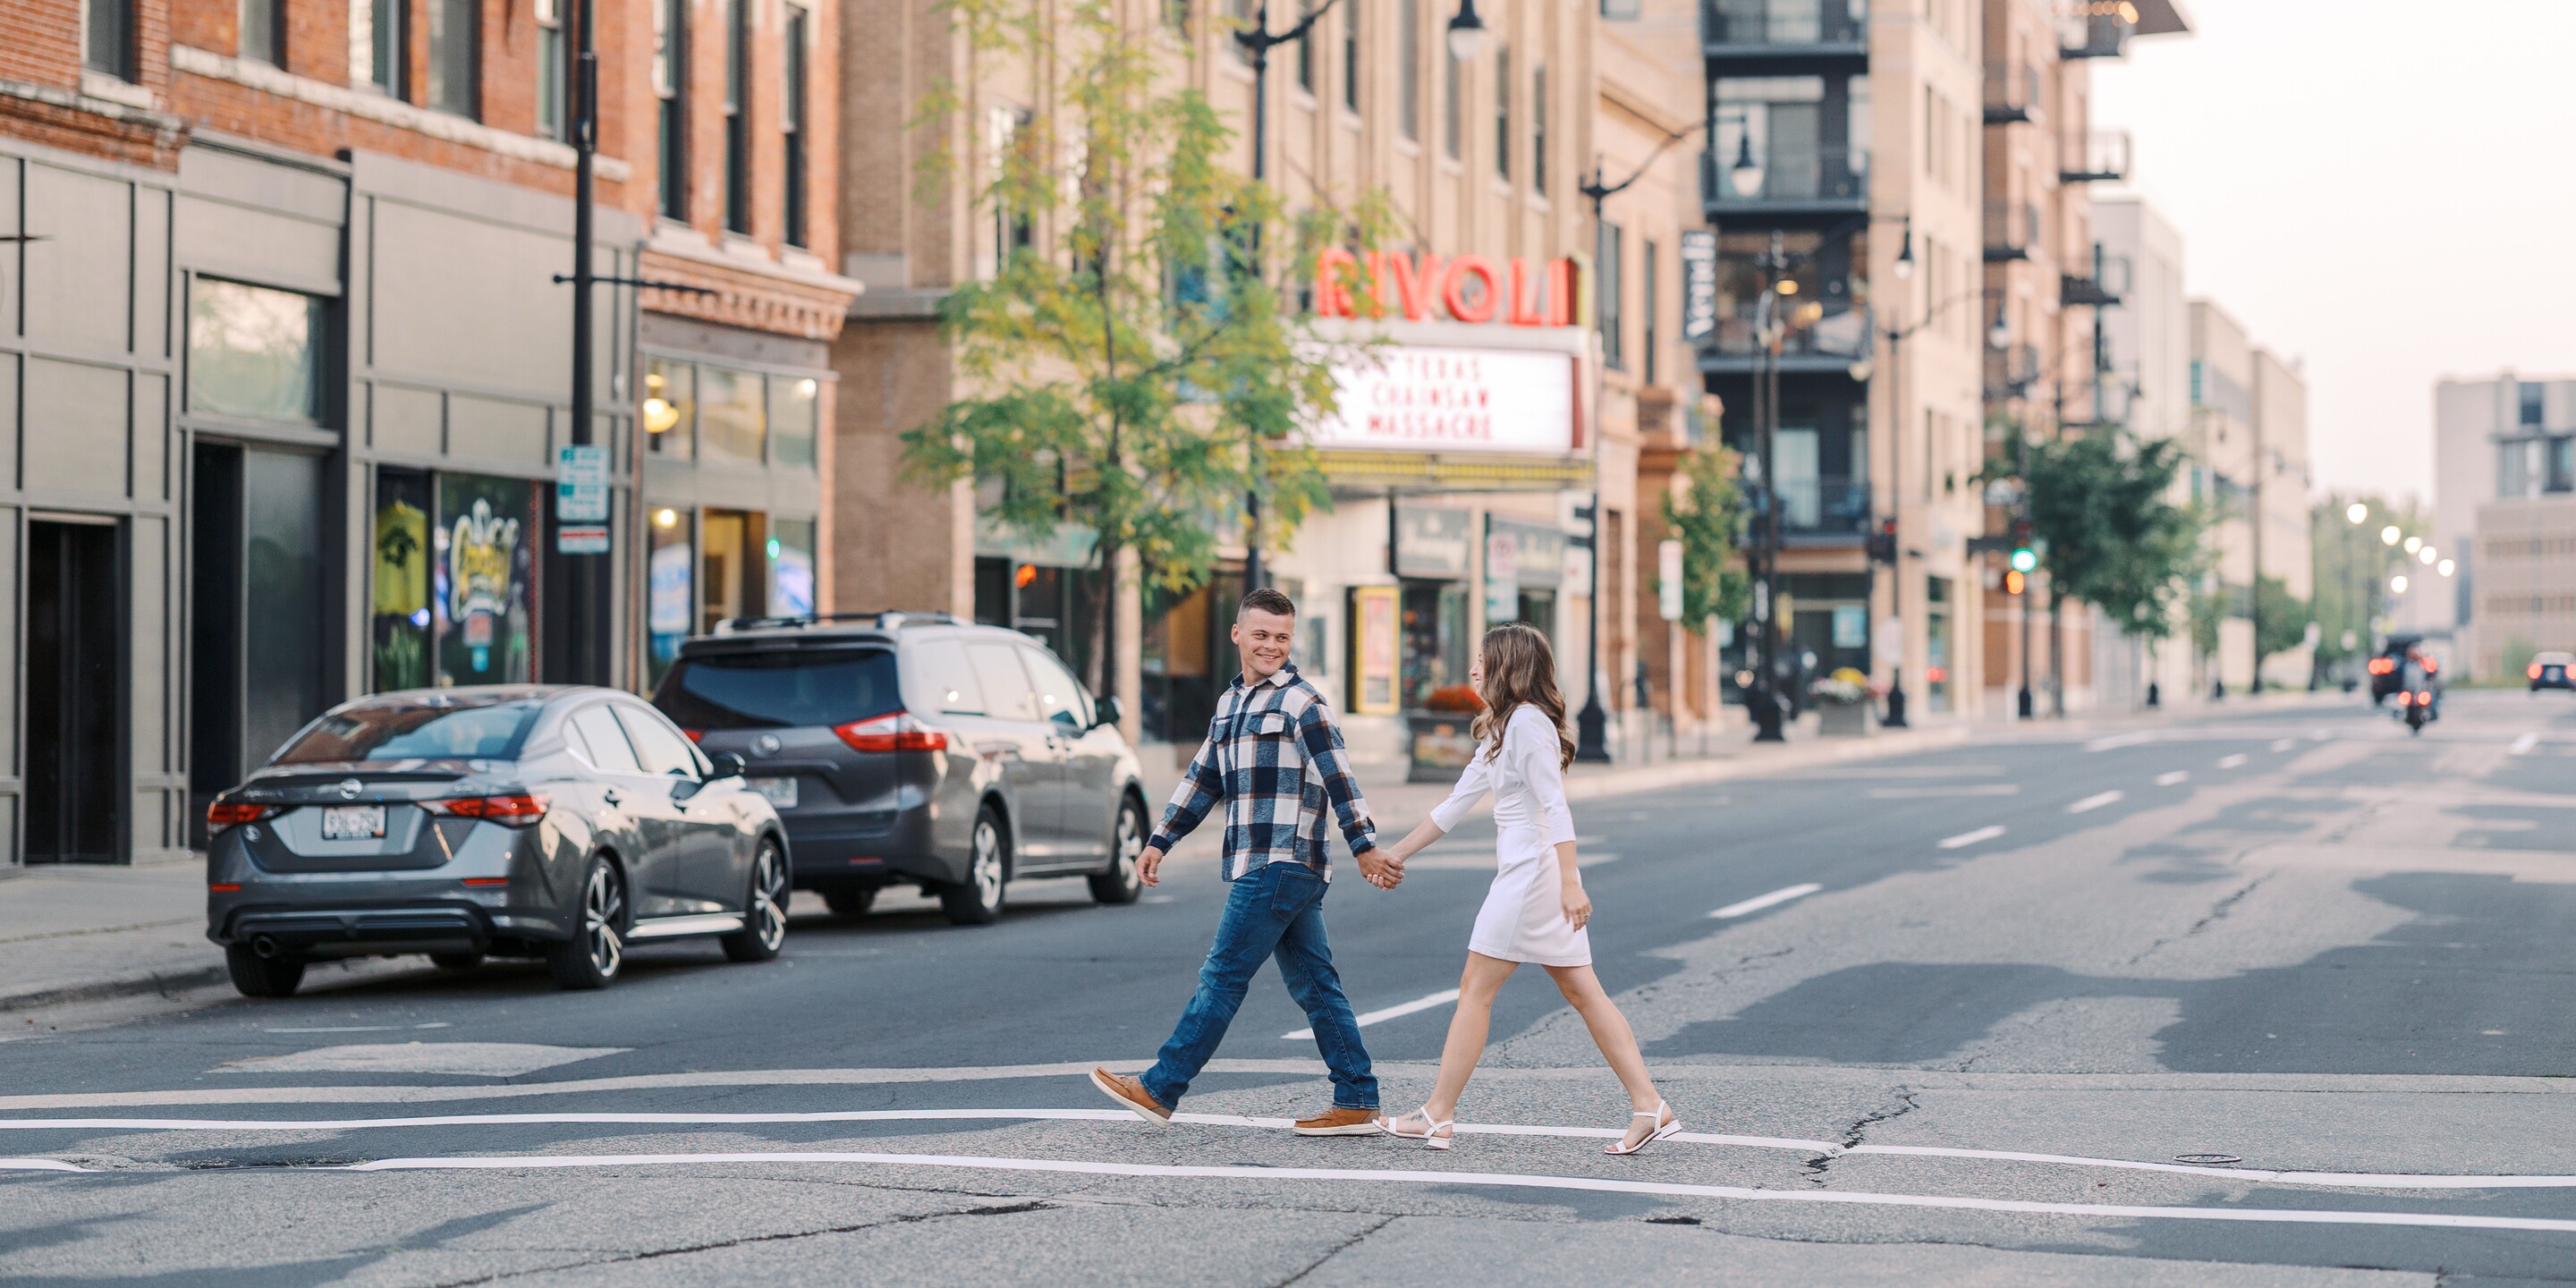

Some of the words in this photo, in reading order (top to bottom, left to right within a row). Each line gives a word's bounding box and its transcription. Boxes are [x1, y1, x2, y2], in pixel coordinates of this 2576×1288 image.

[1317, 248, 1569, 326] RIVOLI
[1682, 233, 1716, 337] Vendi
[1405, 356, 1481, 381] TEXAS
[1372, 383, 1489, 407] CHAINSAW
[1368, 414, 1492, 439] MASSACRE
